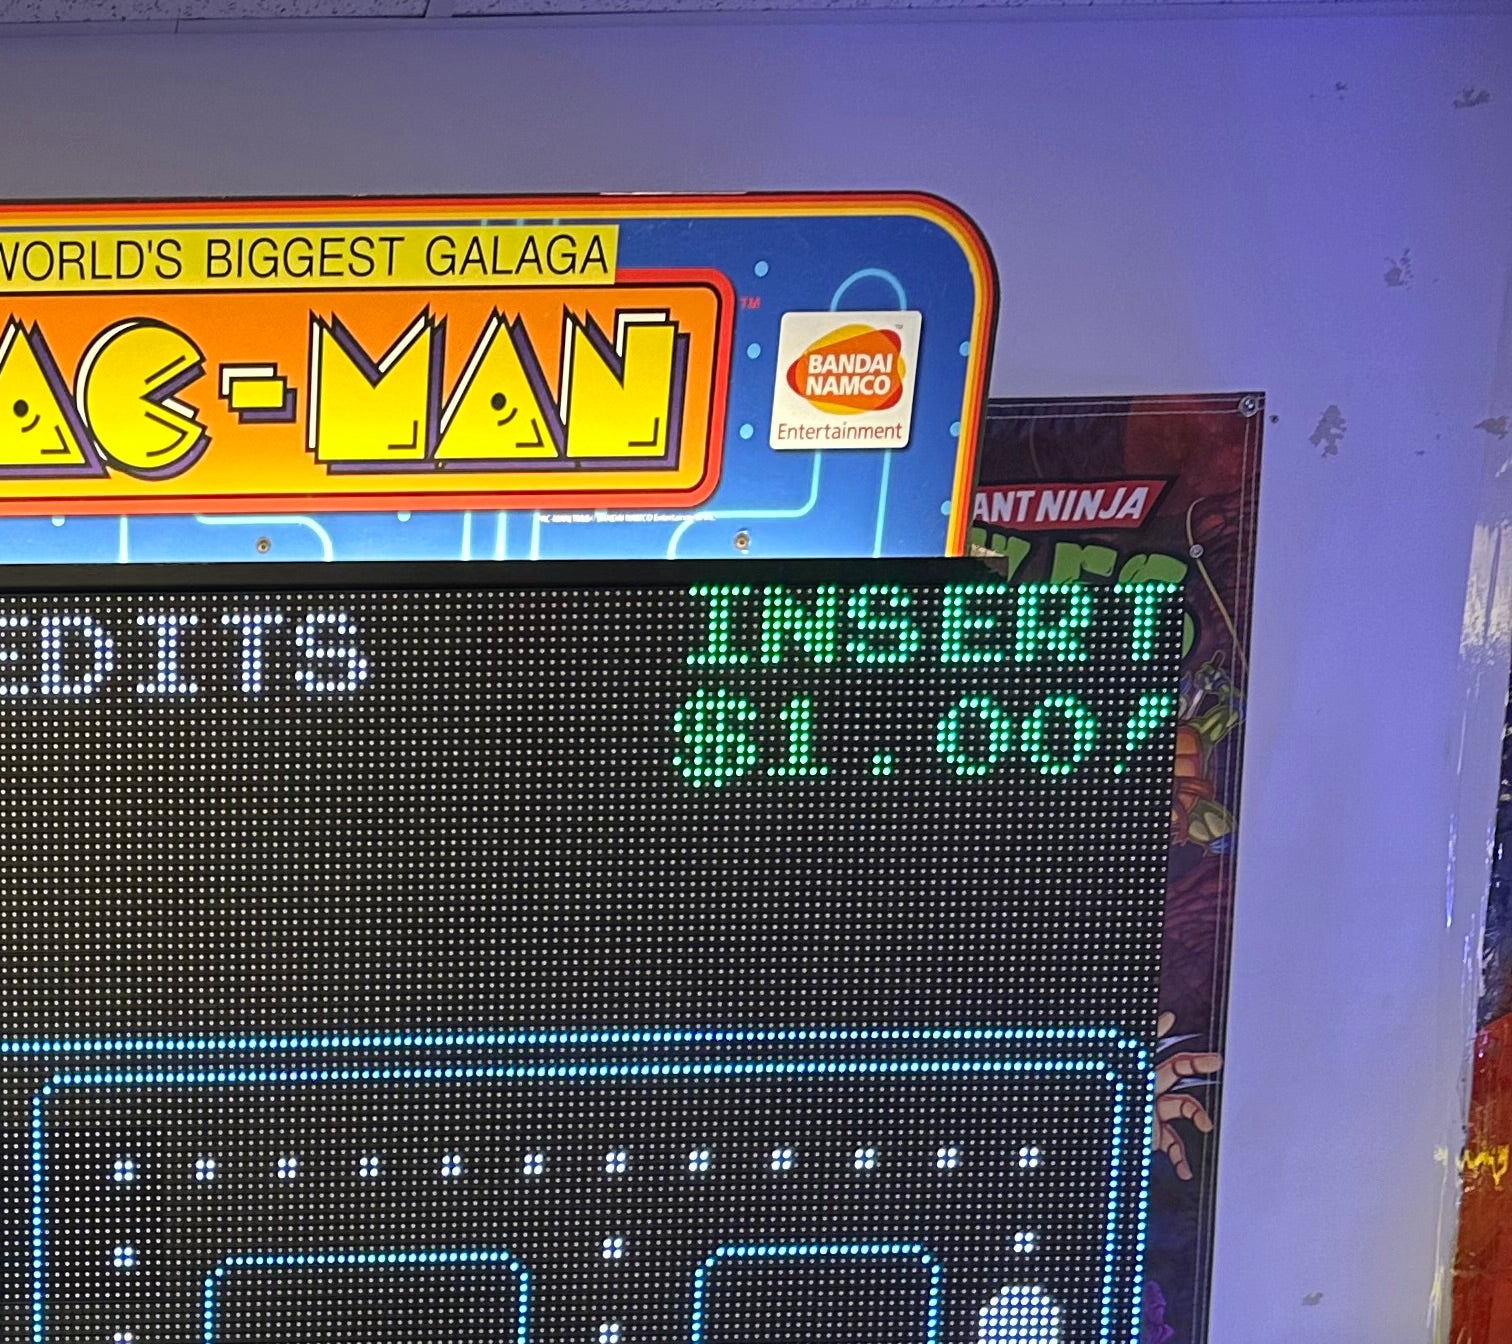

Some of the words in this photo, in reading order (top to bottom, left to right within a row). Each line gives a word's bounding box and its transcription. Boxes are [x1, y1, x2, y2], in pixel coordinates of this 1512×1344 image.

[207, 236, 406, 279] BIGGEST
[426, 234, 609, 275] GALAGA
[807, 353, 893, 374] BANDAI
[805, 374, 892, 396] NAMCO
[777, 421, 903, 440] Entertainment
[974, 491, 1037, 522] ANT
[1035, 486, 1150, 522] NINJA
[686, 583, 1178, 665] INSERT
